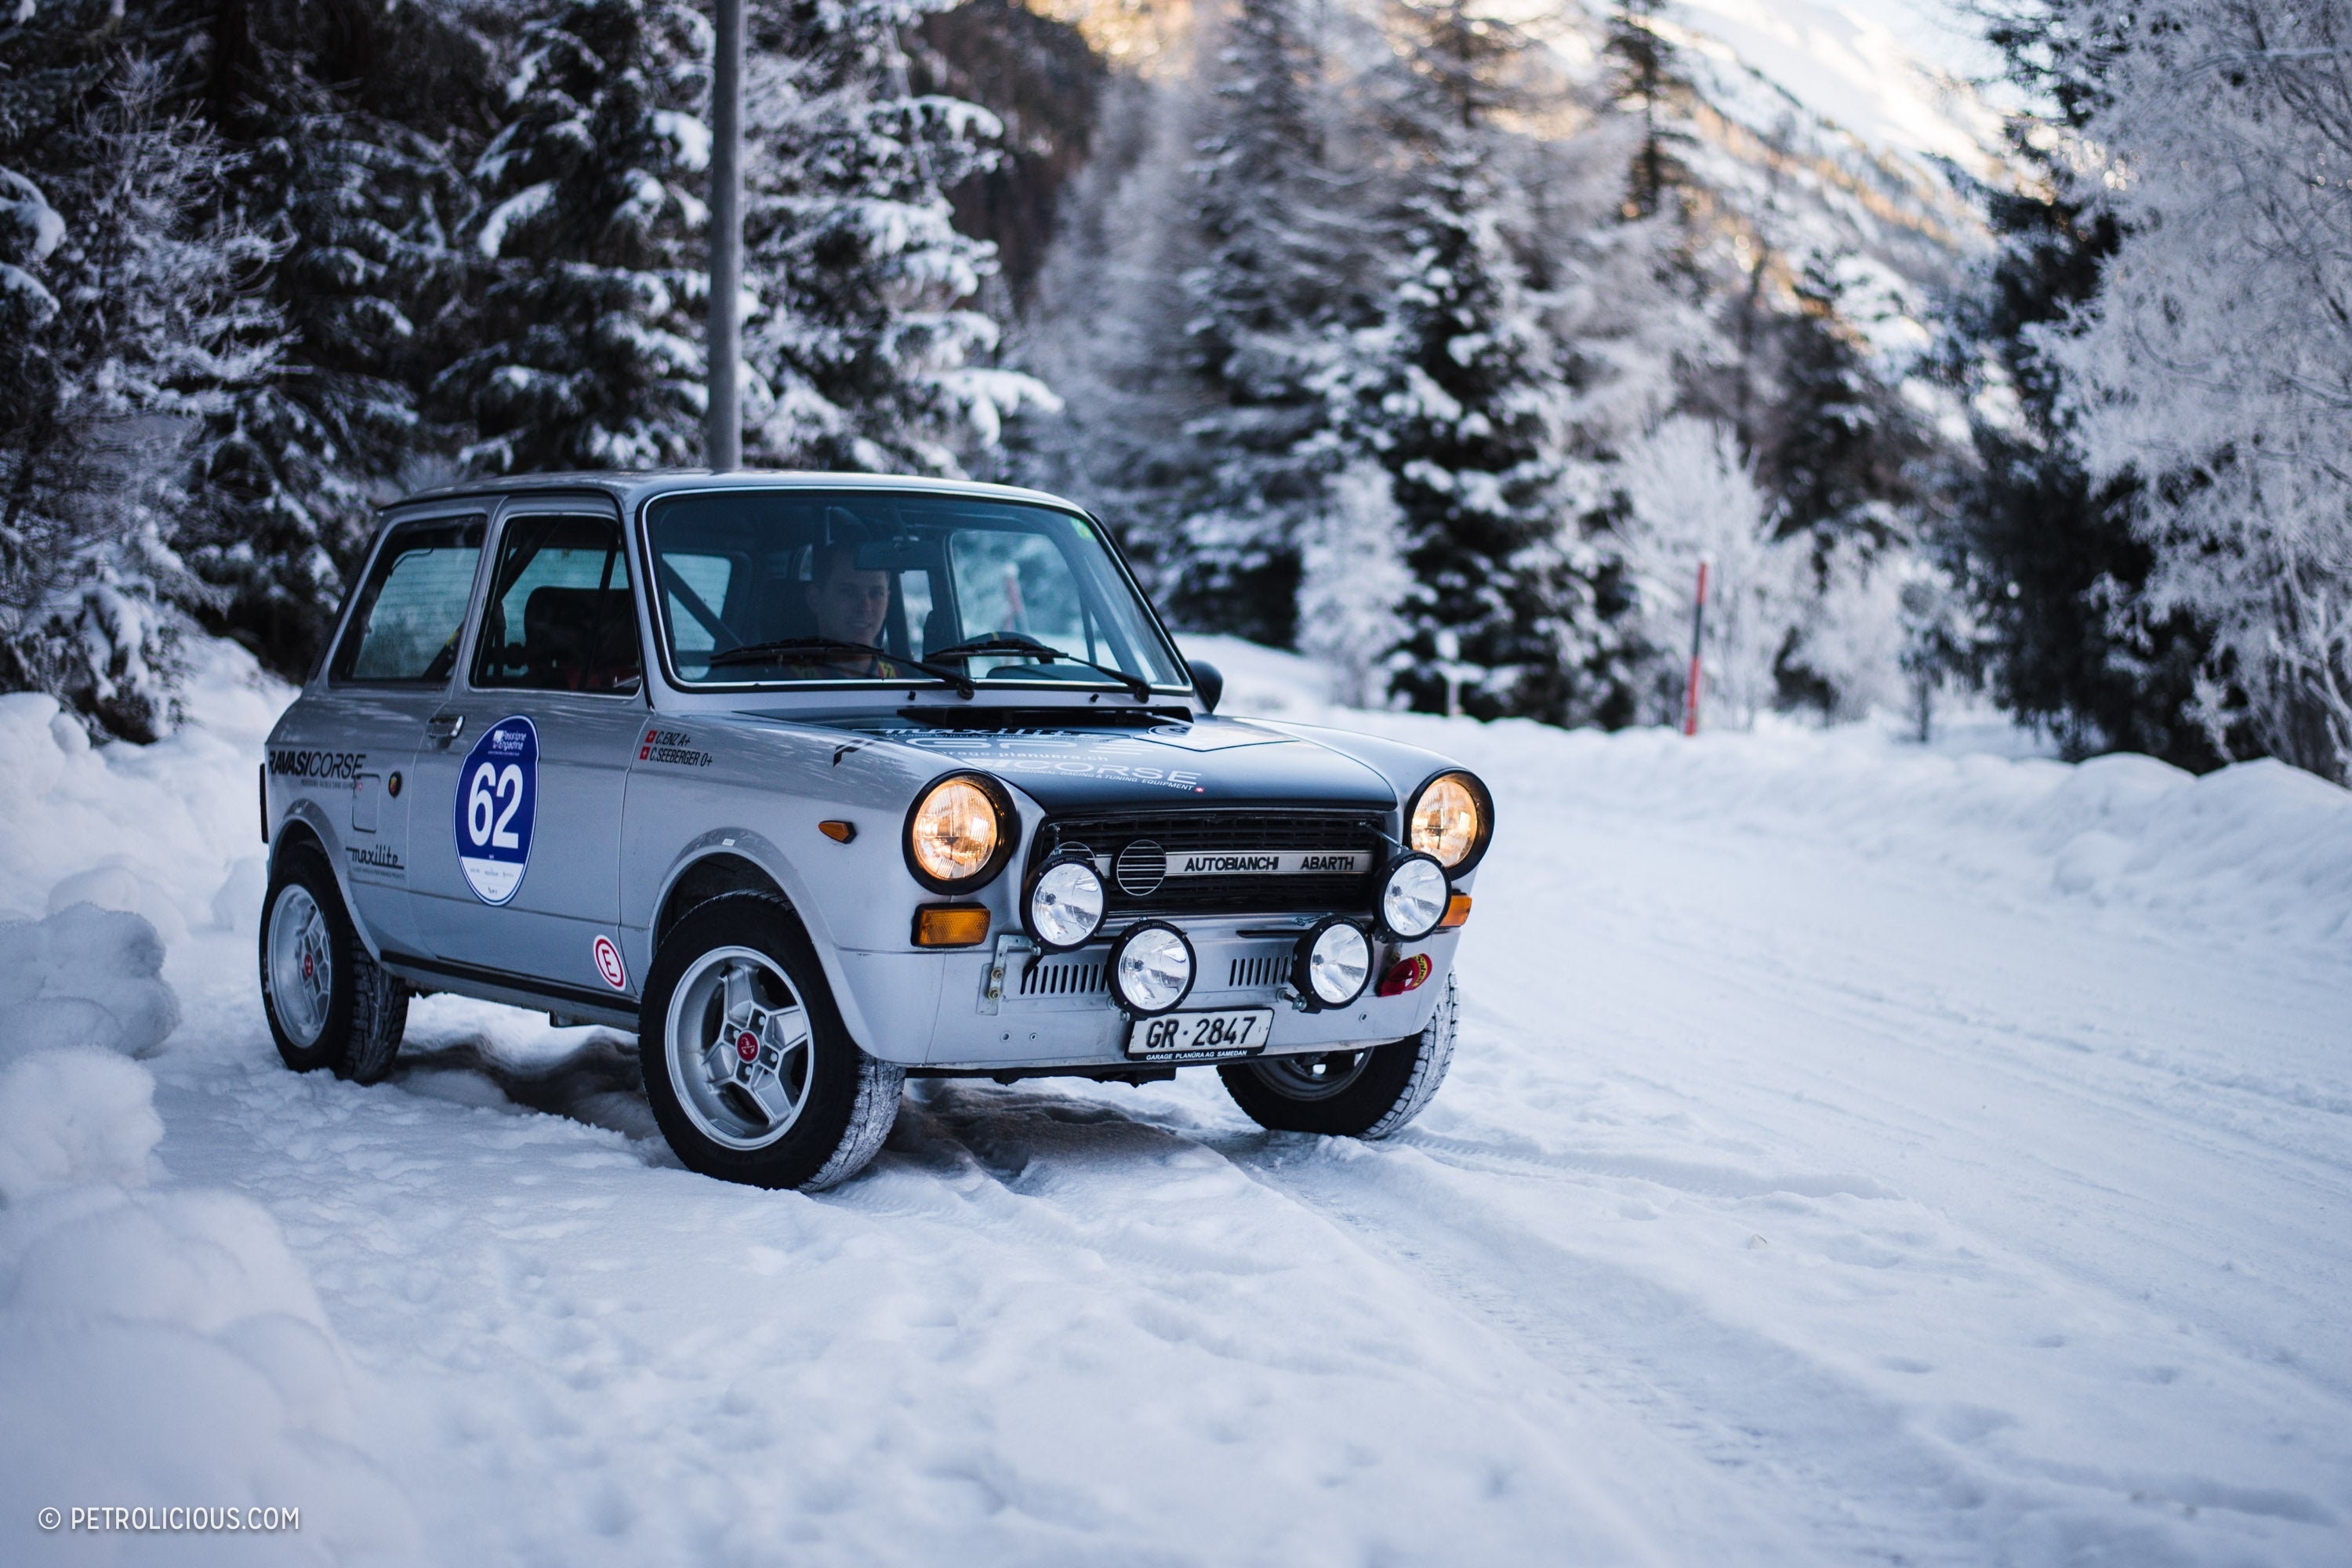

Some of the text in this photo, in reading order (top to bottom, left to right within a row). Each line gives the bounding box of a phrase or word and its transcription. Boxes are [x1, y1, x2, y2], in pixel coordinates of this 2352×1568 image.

[650, 747, 701, 766] C.SEEBERGER
[1142, 779, 1194, 790] EQUIPMENT
[467, 761, 523, 849] 62
[346, 844, 405, 869] maxilite
[1185, 856, 1355, 872] AUTOBIANCHI ABARTH
